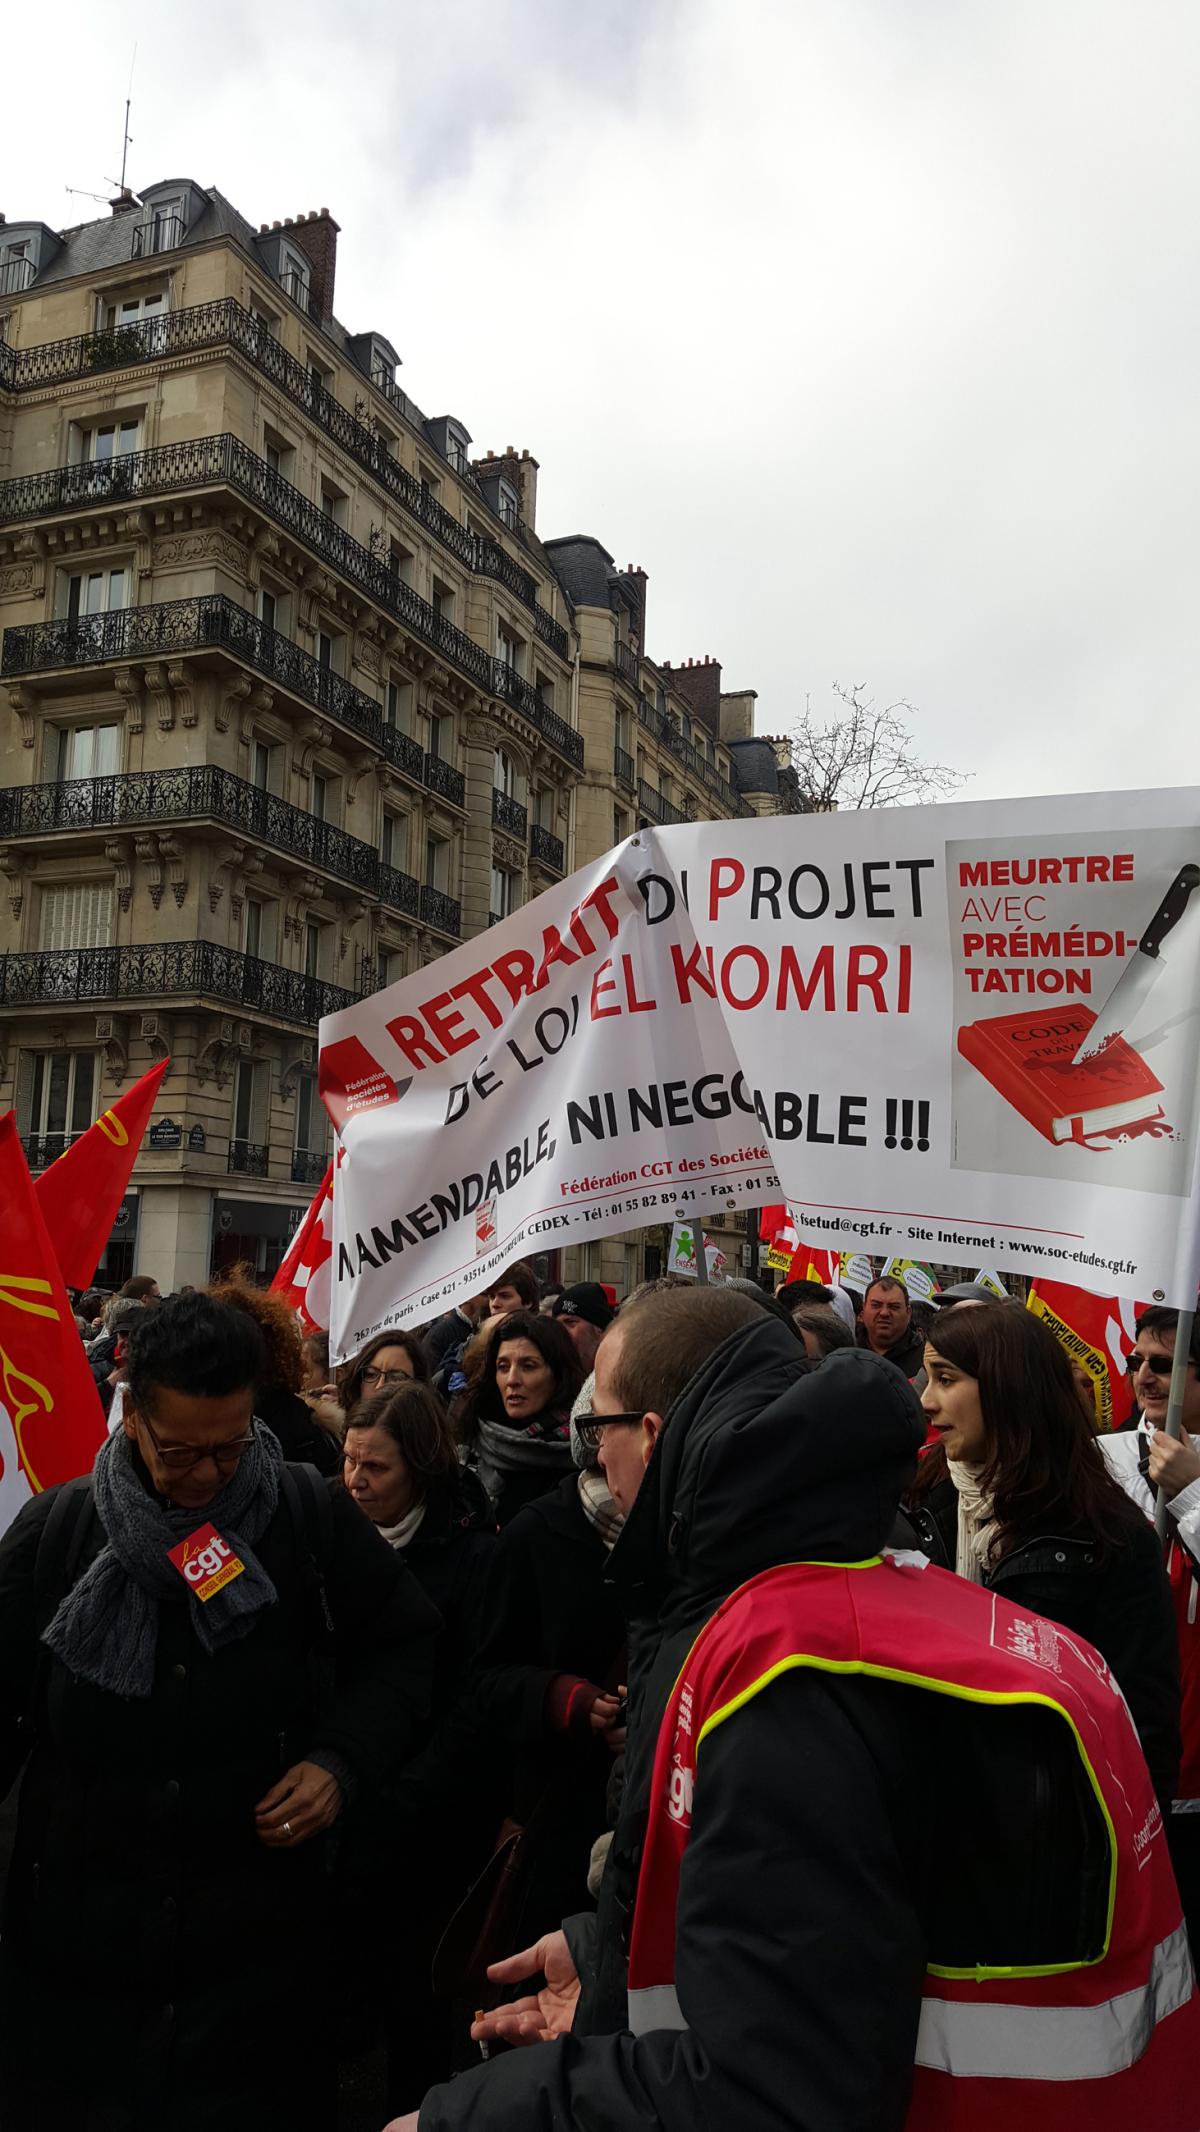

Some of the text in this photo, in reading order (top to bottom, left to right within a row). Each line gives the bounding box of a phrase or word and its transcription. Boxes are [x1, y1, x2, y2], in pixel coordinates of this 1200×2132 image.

[959, 854, 1134, 887] MEURTRE
[961, 895, 1047, 922] AVEC
[962, 923, 1138, 958] PRÉMÉDI-
[385, 876, 619, 1070] RETRAIT
[709, 857, 935, 921] PROJET
[964, 968, 1092, 994] TATION
[443, 1054, 503, 1126] DE
[506, 993, 580, 1073] LOI
[590, 953, 657, 1022] EL
[1011, 1021, 1089, 1042] CODE
[345, 1071, 390, 1093] Fédération
[346, 1082, 387, 1103] sociétés
[346, 1092, 390, 1112] d'études
[566, 1091, 618, 1145] NI
[884, 1098, 930, 1152] !!!
[560, 1169, 637, 1196] Fédération
[640, 1160, 674, 1178] CGT
[678, 1157, 706, 1173] des
[370, 1322, 382, 1334] rue
[384, 1314, 393, 1326] de
[394, 1302, 414, 1324] paris
[421, 1291, 440, 1307] Case
[441, 1281, 456, 1296] 421
[463, 1263, 487, 1286] 93514
[487, 1230, 527, 1271] MONTREUIL
[527, 1214, 571, 1236] CEDEX
[583, 1206, 602, 1222] Tél
[612, 1202, 623, 1216] 01
[626, 1198, 639, 1211] 55
[642, 1195, 658, 1208] 82
[661, 1192, 677, 1205] 89
[681, 1188, 696, 1201] 41
[711, 1182, 734, 1197] Fax
[746, 1176, 761, 1190] 01
[766, 1175, 781, 1189] 55
[800, 1212, 892, 1238] fsetud@cgt.fr
[907, 1226, 934, 1241] Site
[938, 1230, 996, 1249] Internet
[1008, 1239, 1138, 1276] www.soc-etudes.cgt.fr
[183, 1536, 232, 1582] cgt
